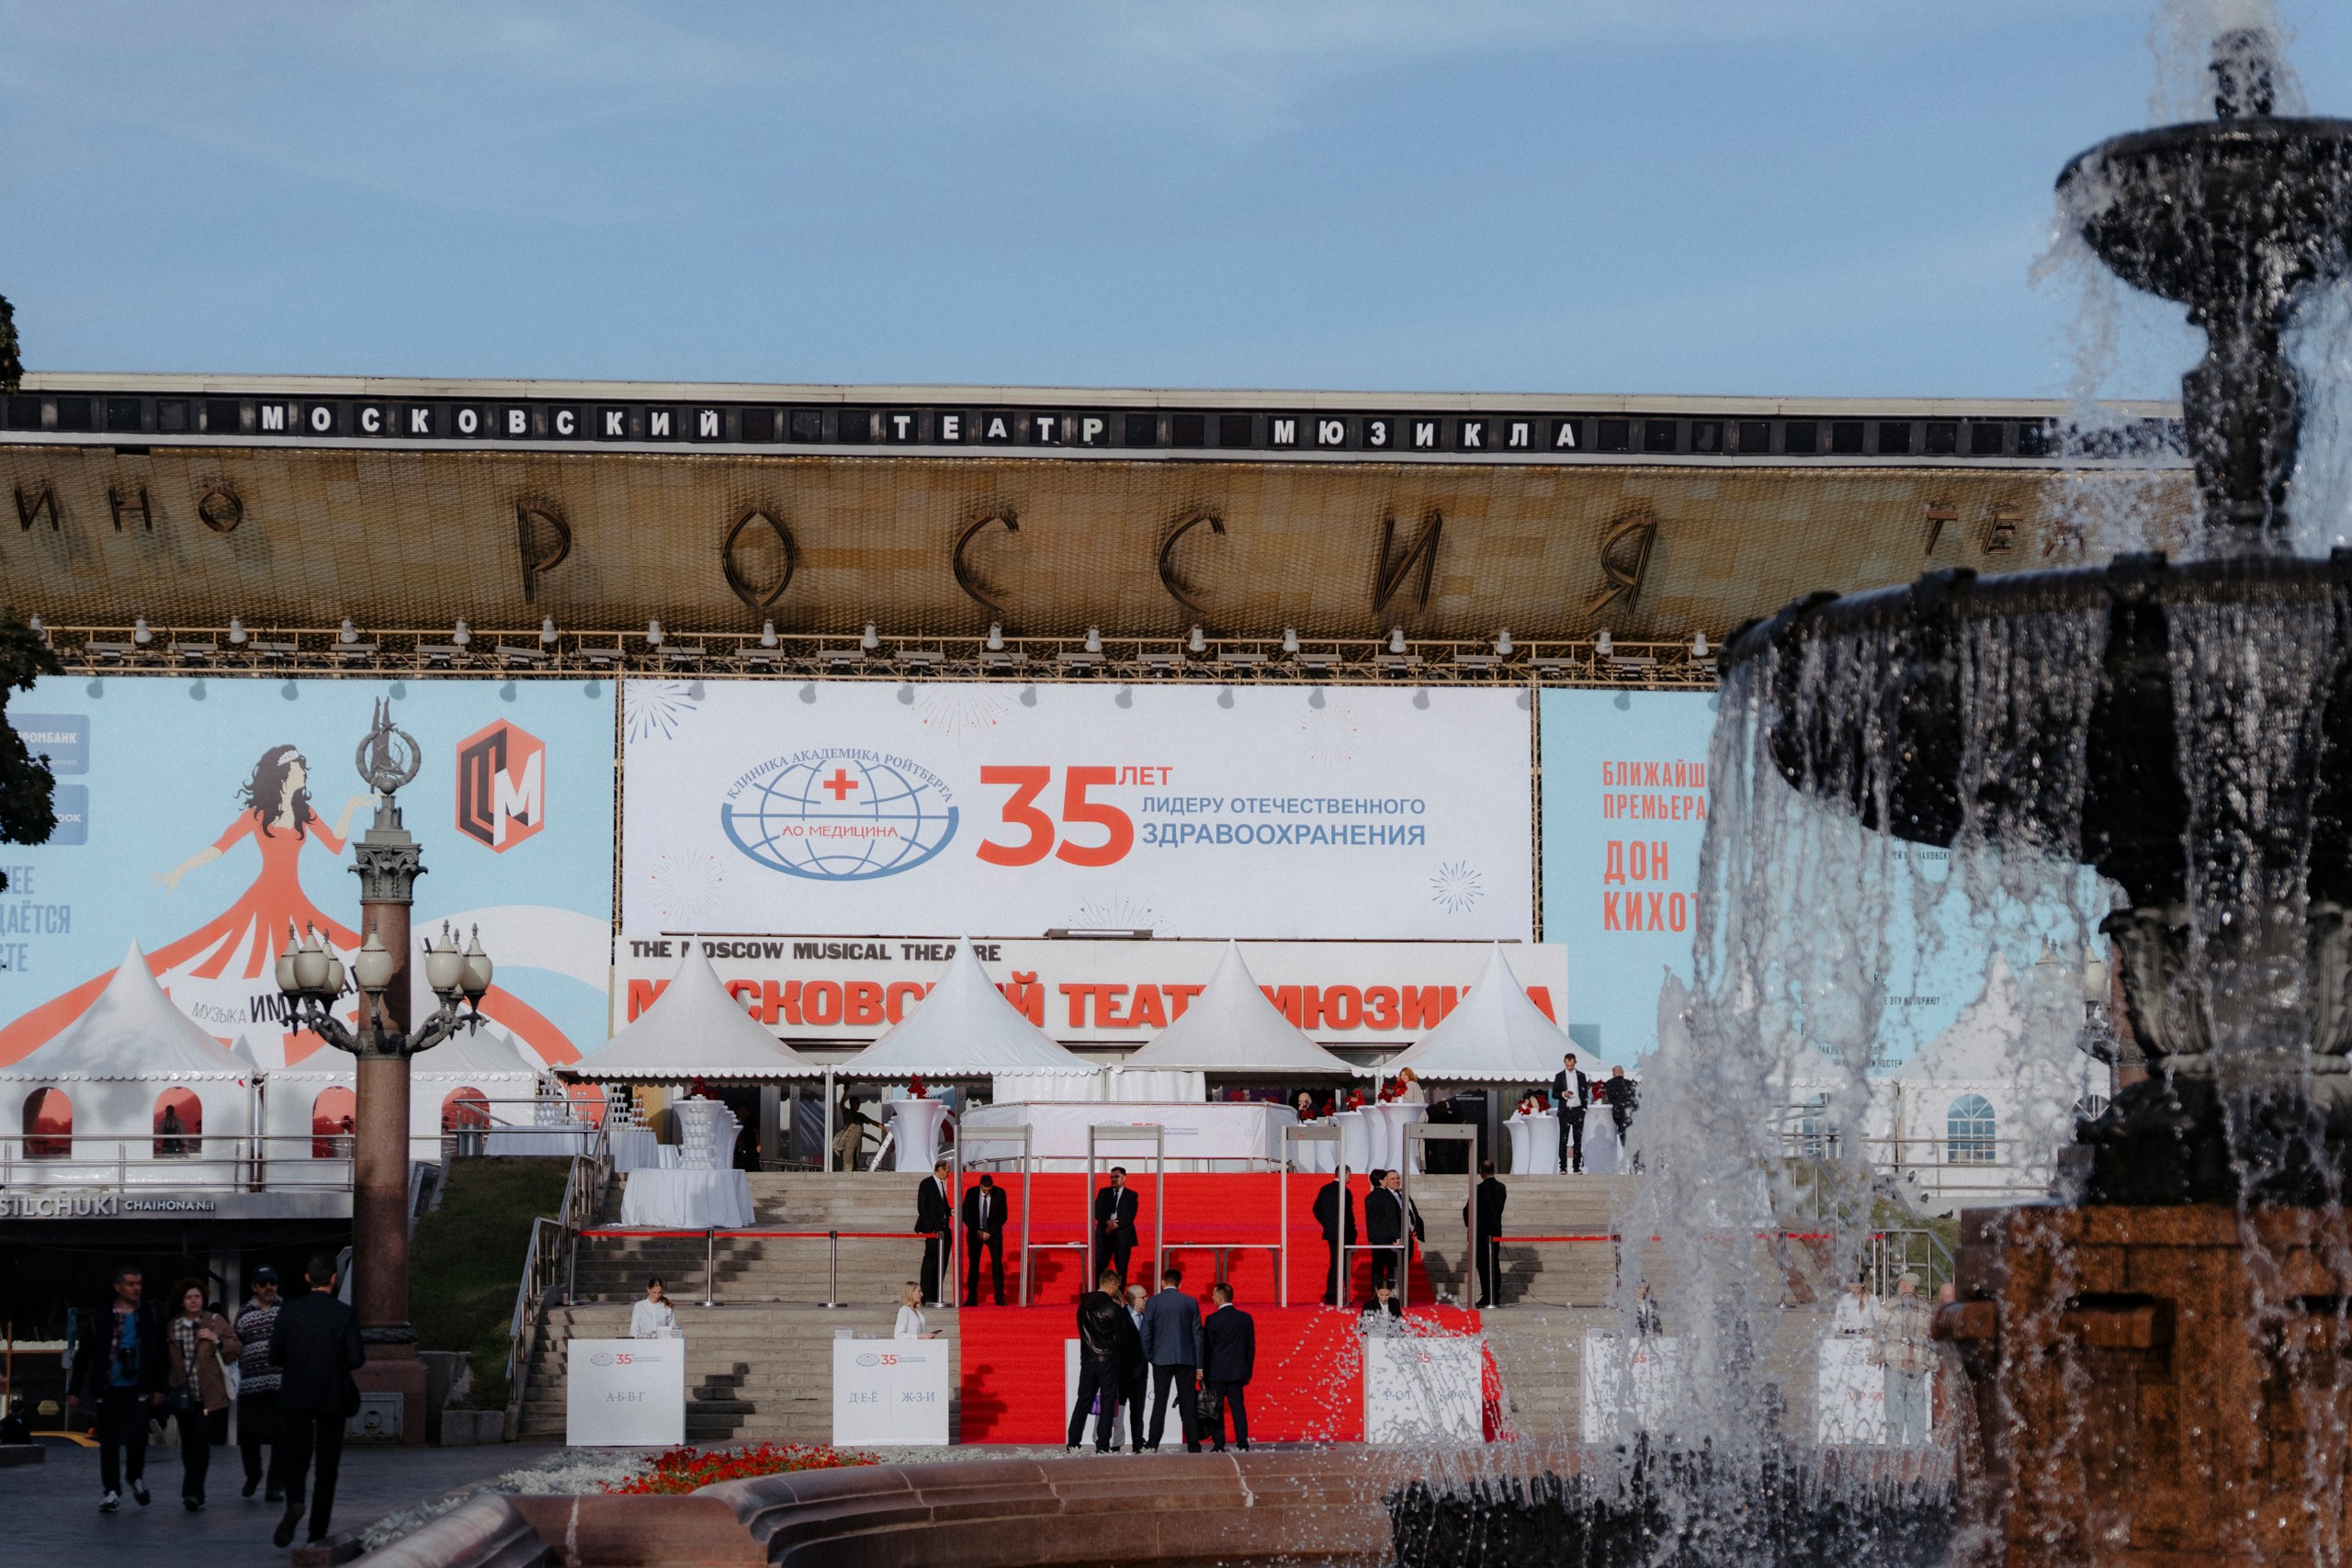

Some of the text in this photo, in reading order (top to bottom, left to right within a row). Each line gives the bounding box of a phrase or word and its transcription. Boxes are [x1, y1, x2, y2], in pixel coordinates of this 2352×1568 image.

[261, 405, 1576, 447] МОСКОВСКИЙ ТЕАТР МЮЗИКЛА
[517, 500, 1656, 617] РОССИЯ
[727, 747, 954, 803] КЛИНИКА АКАДЕМИКА РОЙТБЕРГА
[975, 765, 1173, 867] 35 ЛЕТ
[1142, 796, 1426, 816] ЛИДЕРУ ОТЕЧЕСТВЕННОГО
[1603, 794, 1707, 820] ПРЕМЬЕРА
[782, 826, 899, 840] АО МЕДИЦИНА
[1142, 823, 1426, 848] ЗДРАВООХРАНЕНИЯ
[1603, 840, 1668, 885] ДОН
[0, 942, 28, 972] ТЕ
[629, 941, 673, 957] THE
[793, 942, 892, 961] MUSICAL
[900, 943, 1001, 962] THEARE
[191, 1001, 247, 1024] МУЗЫКА
[1058, 983, 1207, 1029] ТЕАТ
[124, 1201, 194, 1212] CHAIHONA
[616, 1353, 633, 1365] 35
[881, 1354, 898, 1365] 35
[605, 1391, 646, 1402] А-Б-В-Г
[849, 1391, 878, 1404] Д-Е-Ё
[901, 1392, 935, 1403] Ж-З-И
